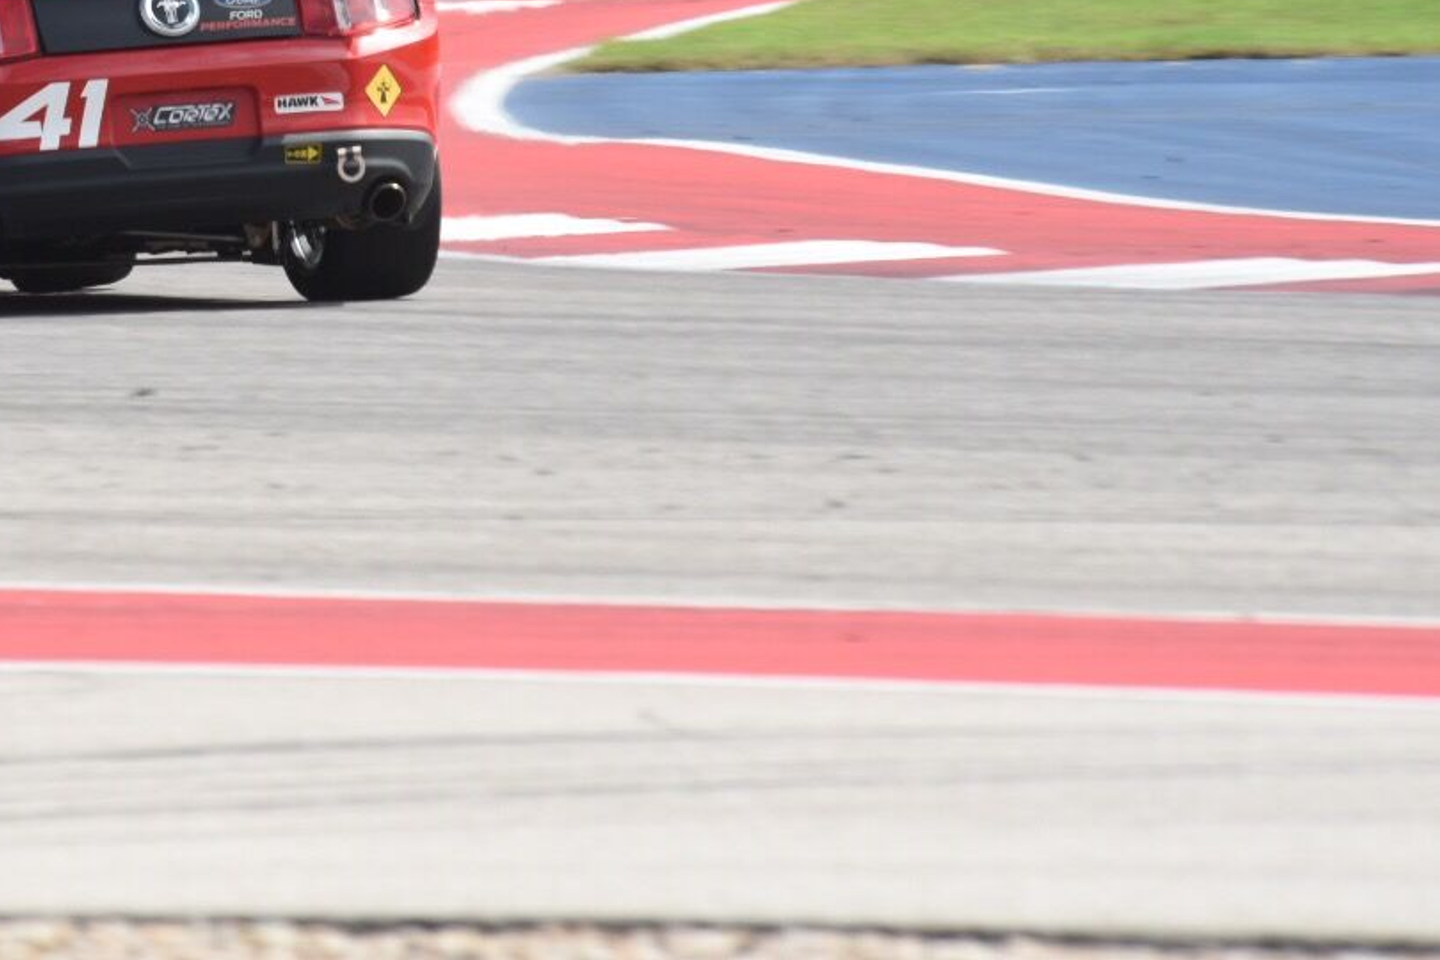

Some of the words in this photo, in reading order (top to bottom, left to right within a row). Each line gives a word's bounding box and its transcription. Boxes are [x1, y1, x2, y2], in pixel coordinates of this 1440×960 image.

[229, 9, 263, 20] FORD
[200, 17, 297, 32] PERFORMANCE
[277, 96, 319, 109] HAWK
